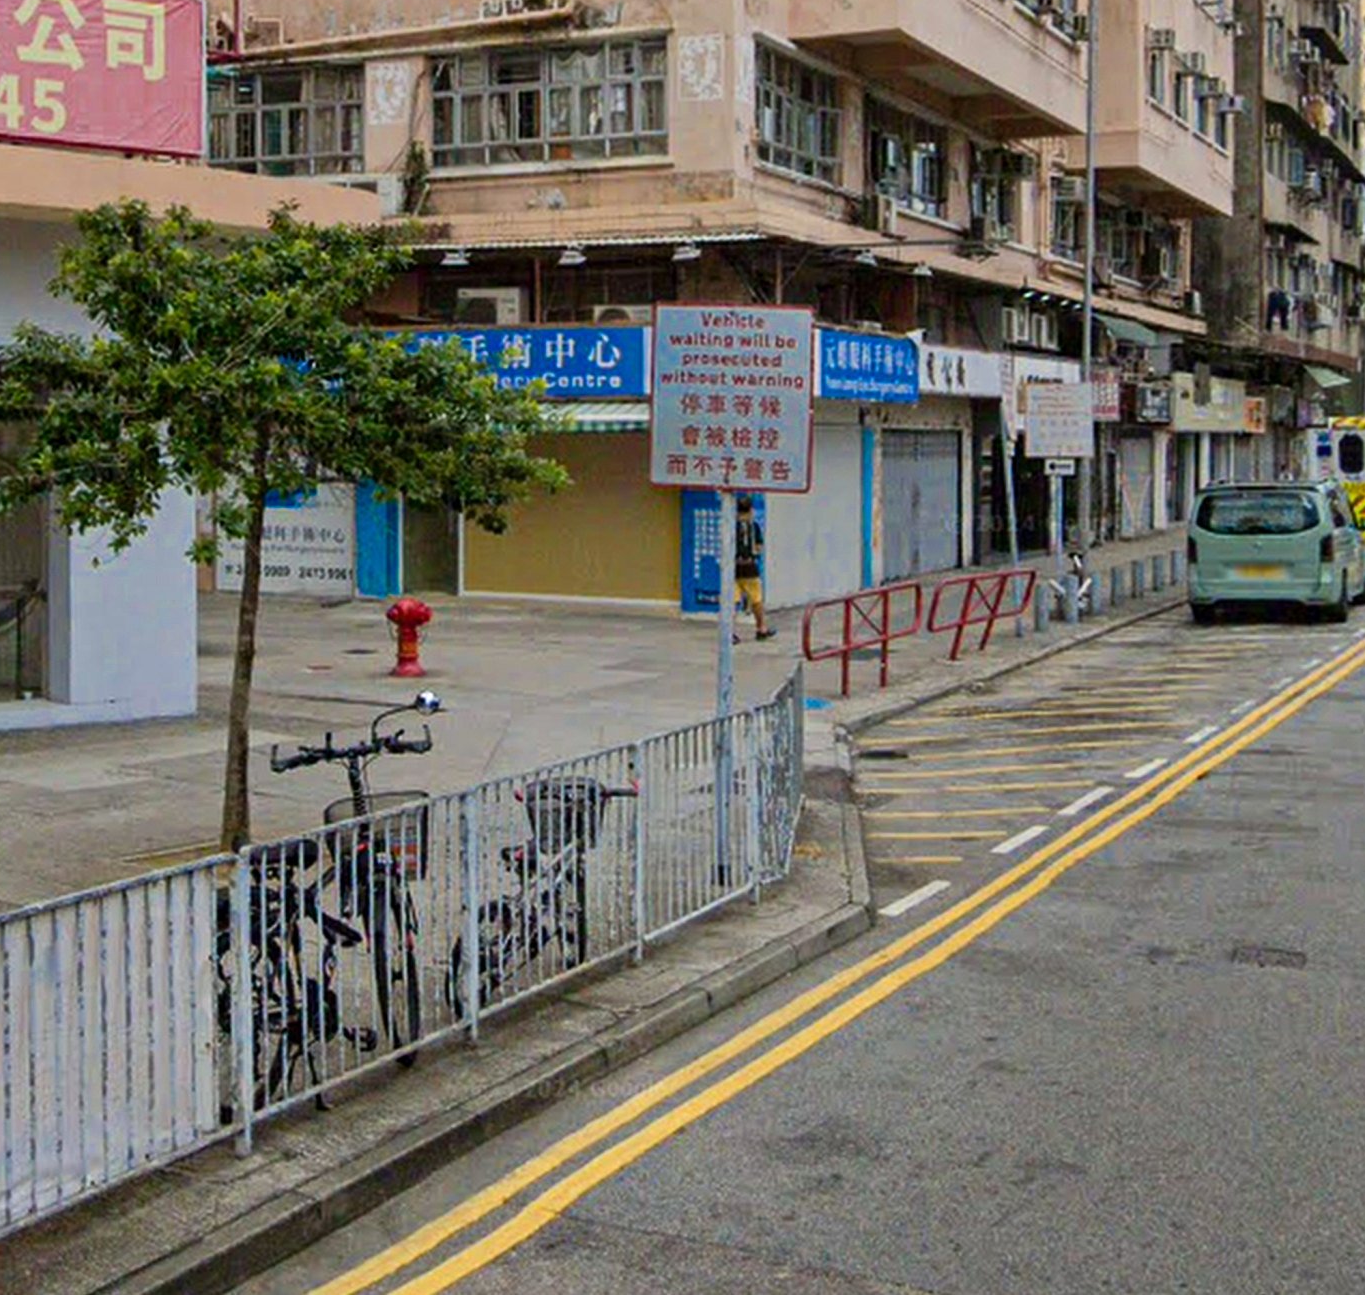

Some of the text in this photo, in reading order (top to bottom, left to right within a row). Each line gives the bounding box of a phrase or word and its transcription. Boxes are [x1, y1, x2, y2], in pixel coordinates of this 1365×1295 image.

[700, 310, 766, 328] Vehicle
[669, 333, 797, 349] waiting will be
[682, 353, 783, 368] prosecuted
[541, 371, 622, 389] Centre
[661, 369, 805, 390] without warning
[681, 393, 782, 419] 停車等候
[682, 425, 780, 451] 會被檢控
[666, 454, 792, 482] 而不予警告
